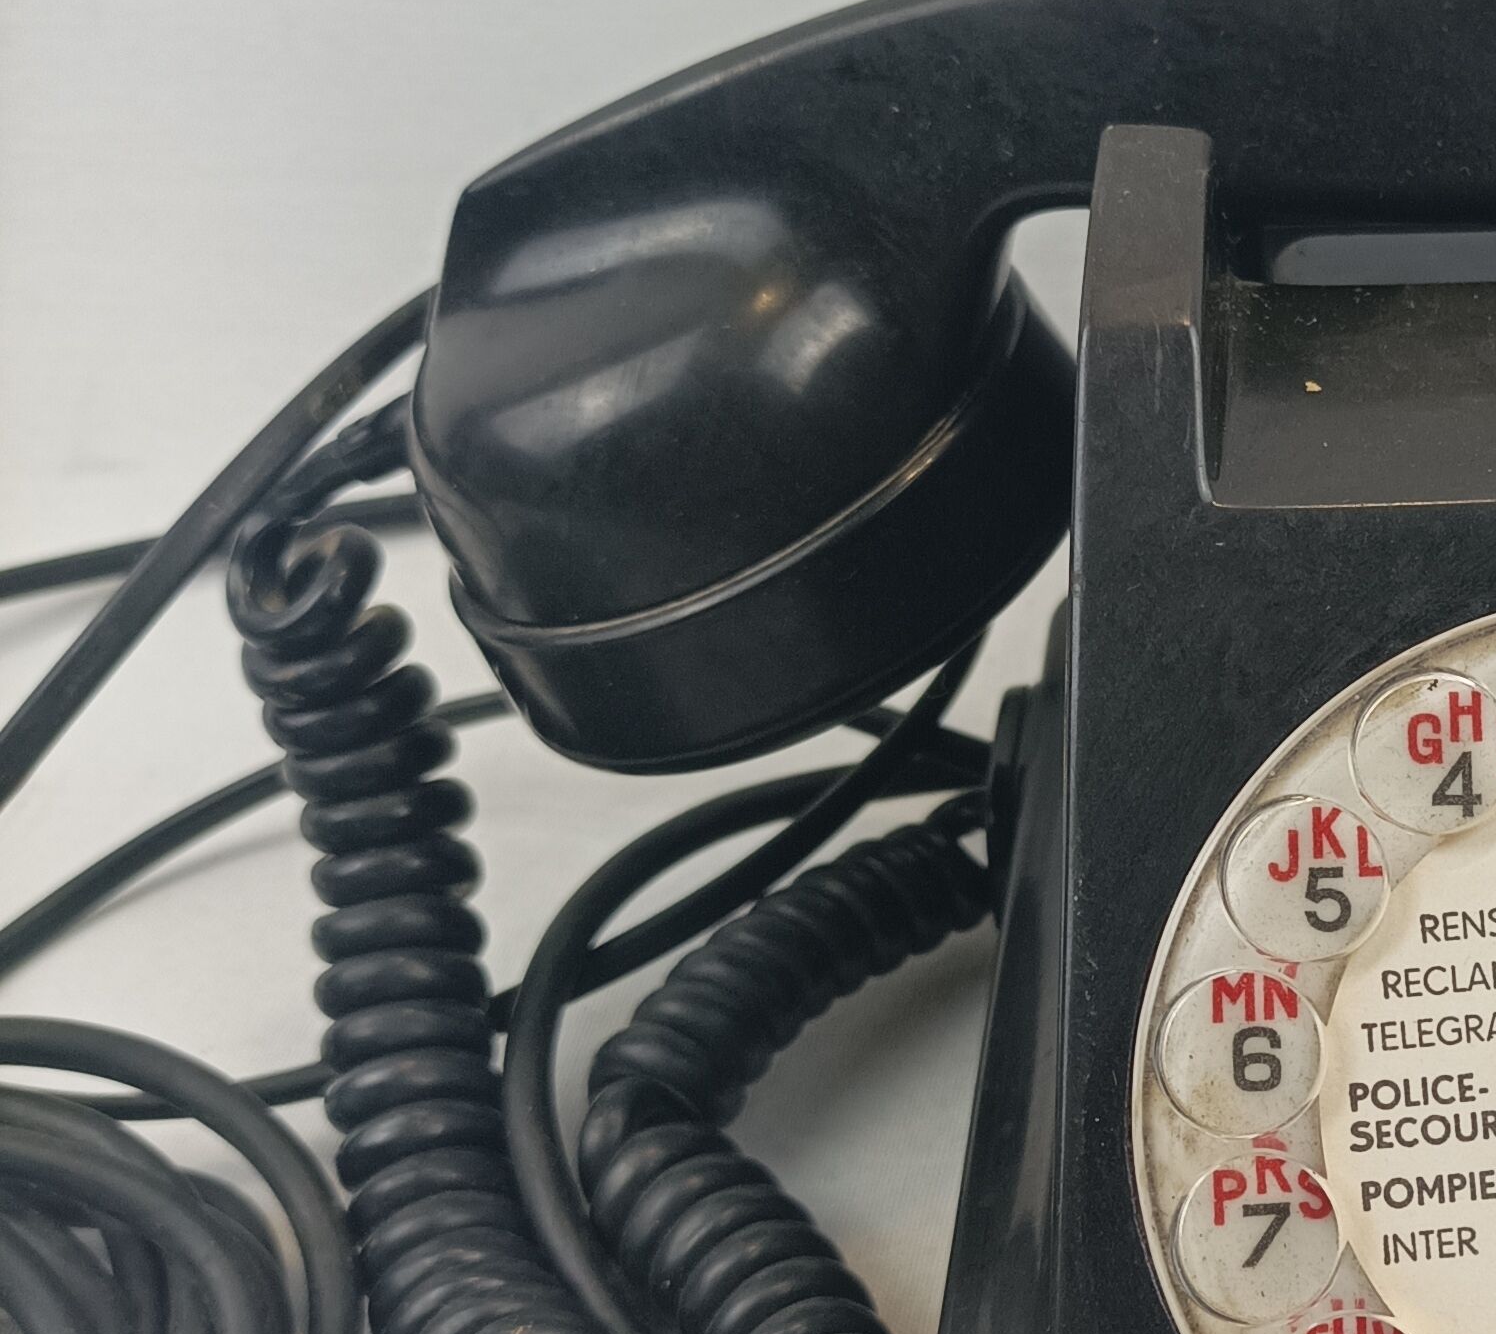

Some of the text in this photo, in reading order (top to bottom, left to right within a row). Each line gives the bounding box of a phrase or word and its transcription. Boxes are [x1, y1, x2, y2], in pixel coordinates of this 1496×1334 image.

[1432, 751, 1482, 817] 4
[1268, 806, 1383, 882] JKL
[1304, 867, 1351, 932] 5
[1212, 973, 1298, 1024] MN
[1233, 1027, 1282, 1092] 6
[1348, 1072, 1489, 1112] POLICE-
[1213, 1156, 1334, 1226] PRS
[1242, 1202, 1292, 1269] 7
[1382, 1225, 1479, 1266] INTER
